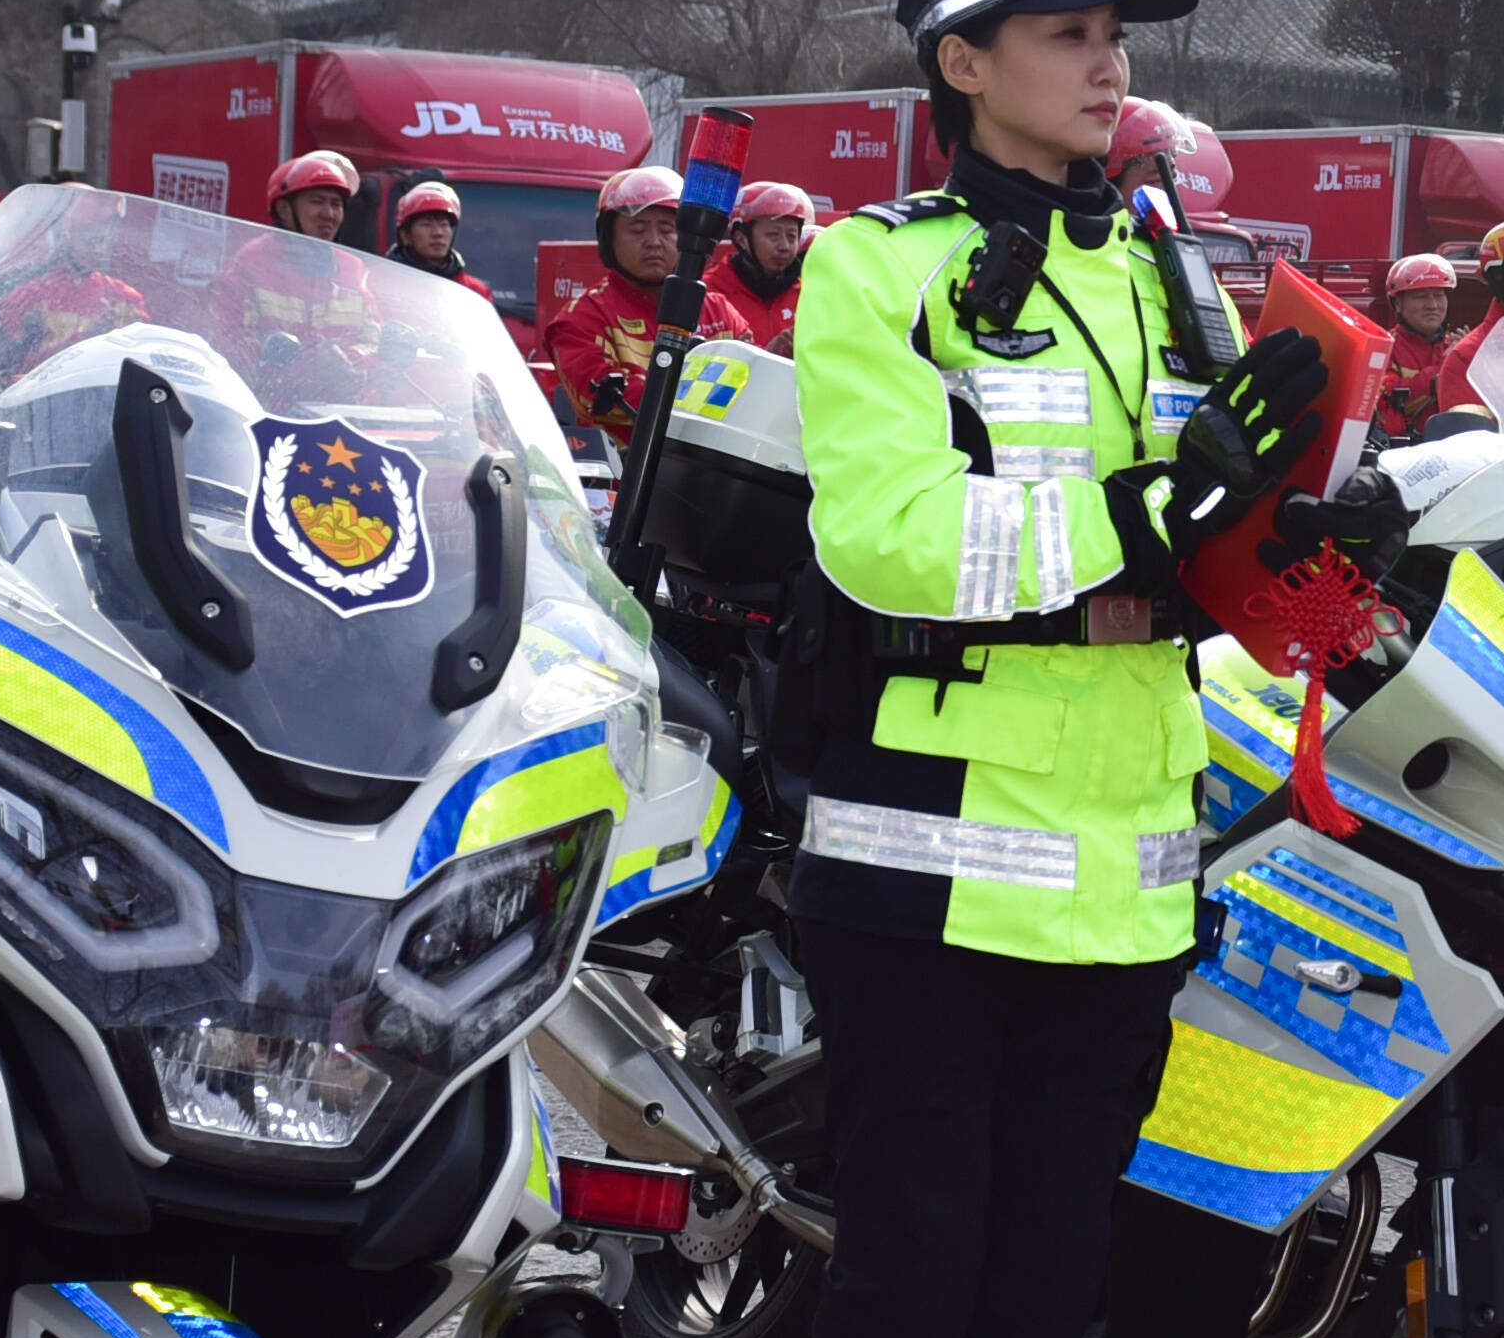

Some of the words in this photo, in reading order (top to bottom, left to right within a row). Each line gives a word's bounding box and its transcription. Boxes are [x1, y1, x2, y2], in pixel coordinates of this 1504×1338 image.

[400, 101, 501, 137] JDL
[502, 105, 552, 118] Express
[507, 118, 627, 154] 京东快递
